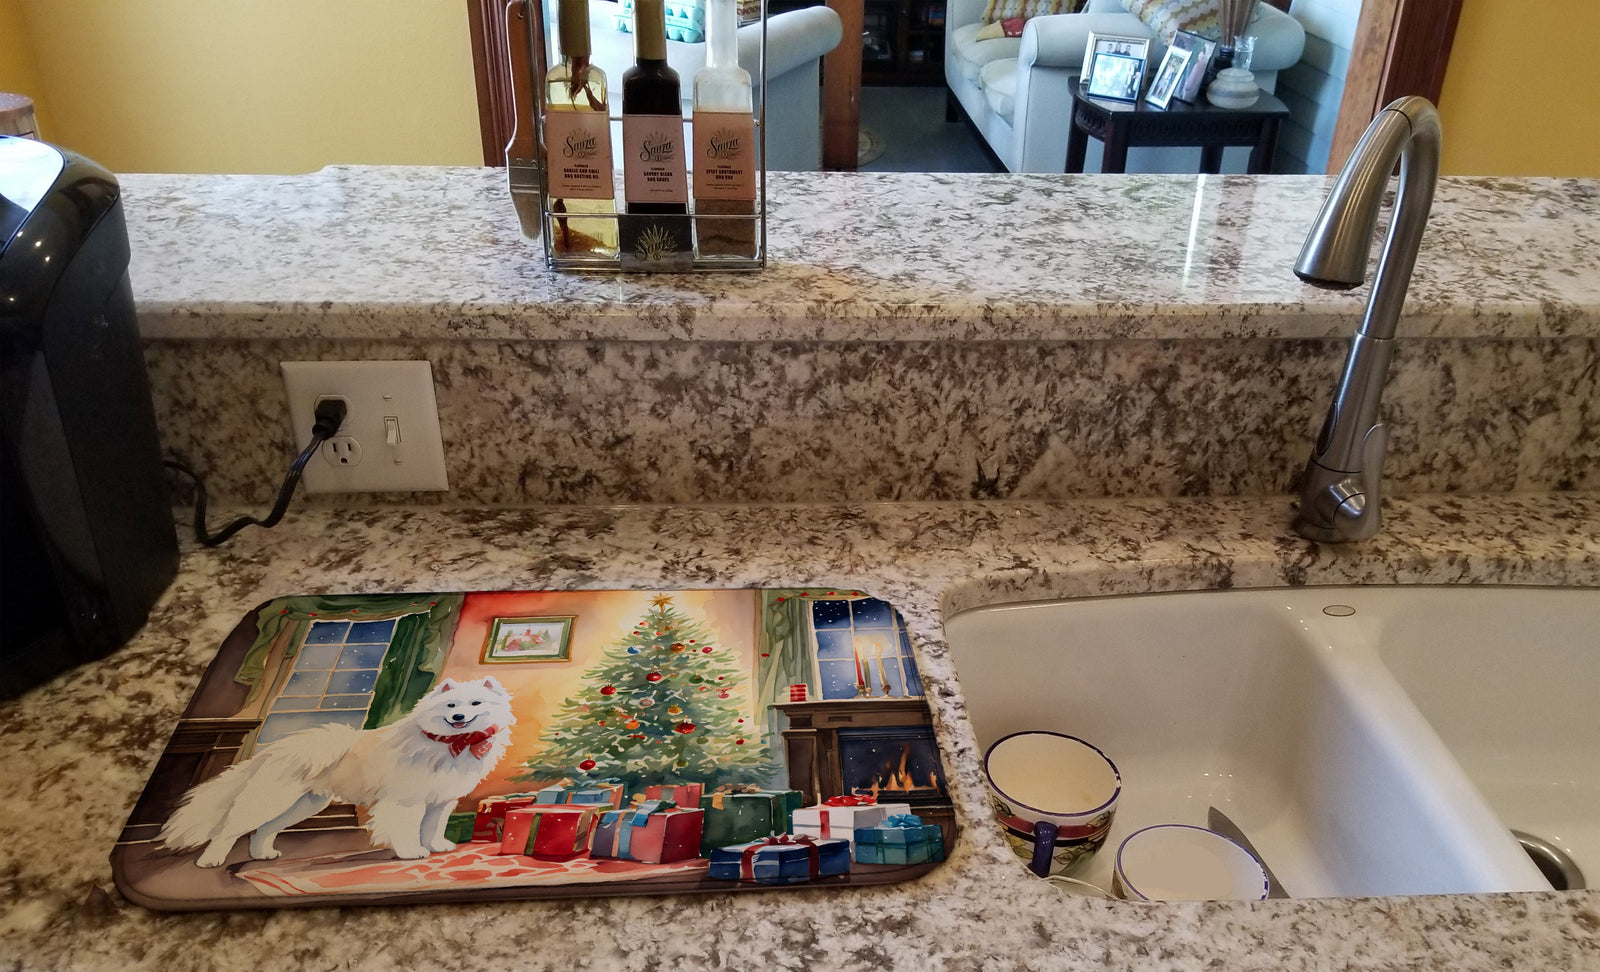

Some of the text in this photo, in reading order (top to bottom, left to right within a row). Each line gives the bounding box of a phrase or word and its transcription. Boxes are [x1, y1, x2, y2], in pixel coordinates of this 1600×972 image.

[563, 136, 597, 158] Sauza
[640, 140, 673, 162] Sauza
[707, 137, 739, 159] Sauza
